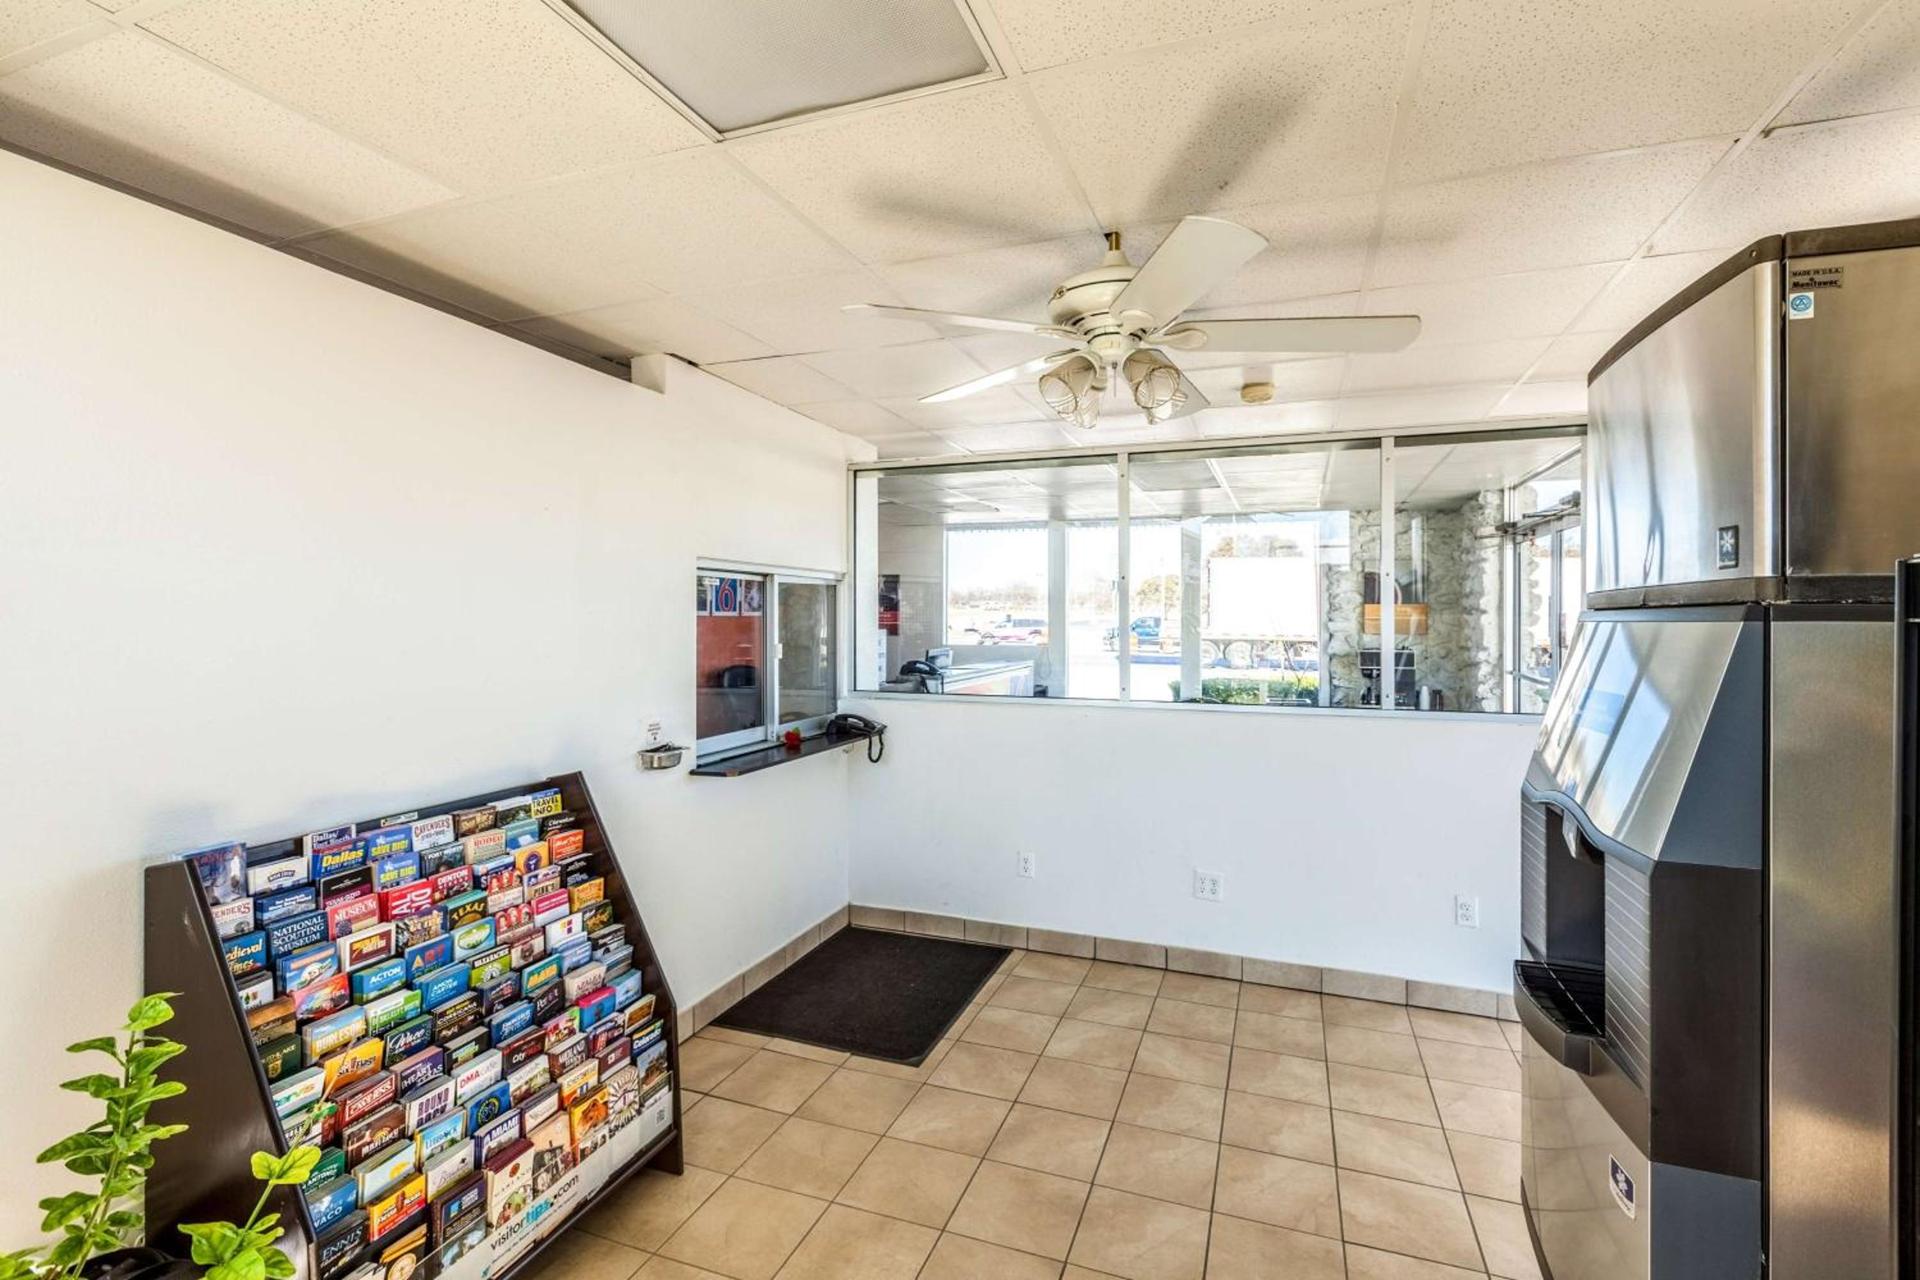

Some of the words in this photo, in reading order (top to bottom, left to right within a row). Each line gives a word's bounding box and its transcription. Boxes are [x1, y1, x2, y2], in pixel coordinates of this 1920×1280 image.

[719, 577, 735, 611] 6
[533, 796, 559, 809] TRAVEL
[535, 805, 553, 817] INFO
[321, 848, 365, 868] Dallas
[335, 899, 377, 919] MUSEUM
[451, 901, 485, 921] TEXAS
[272, 915, 324, 939] NATIONAL
[273, 923, 325, 947] SCOUTING
[279, 933, 321, 954] MUSEUM
[369, 966, 402, 984] ACTON
[490, 1174, 579, 1251] visitortips.com
[321, 1225, 364, 1260] ENNIS
